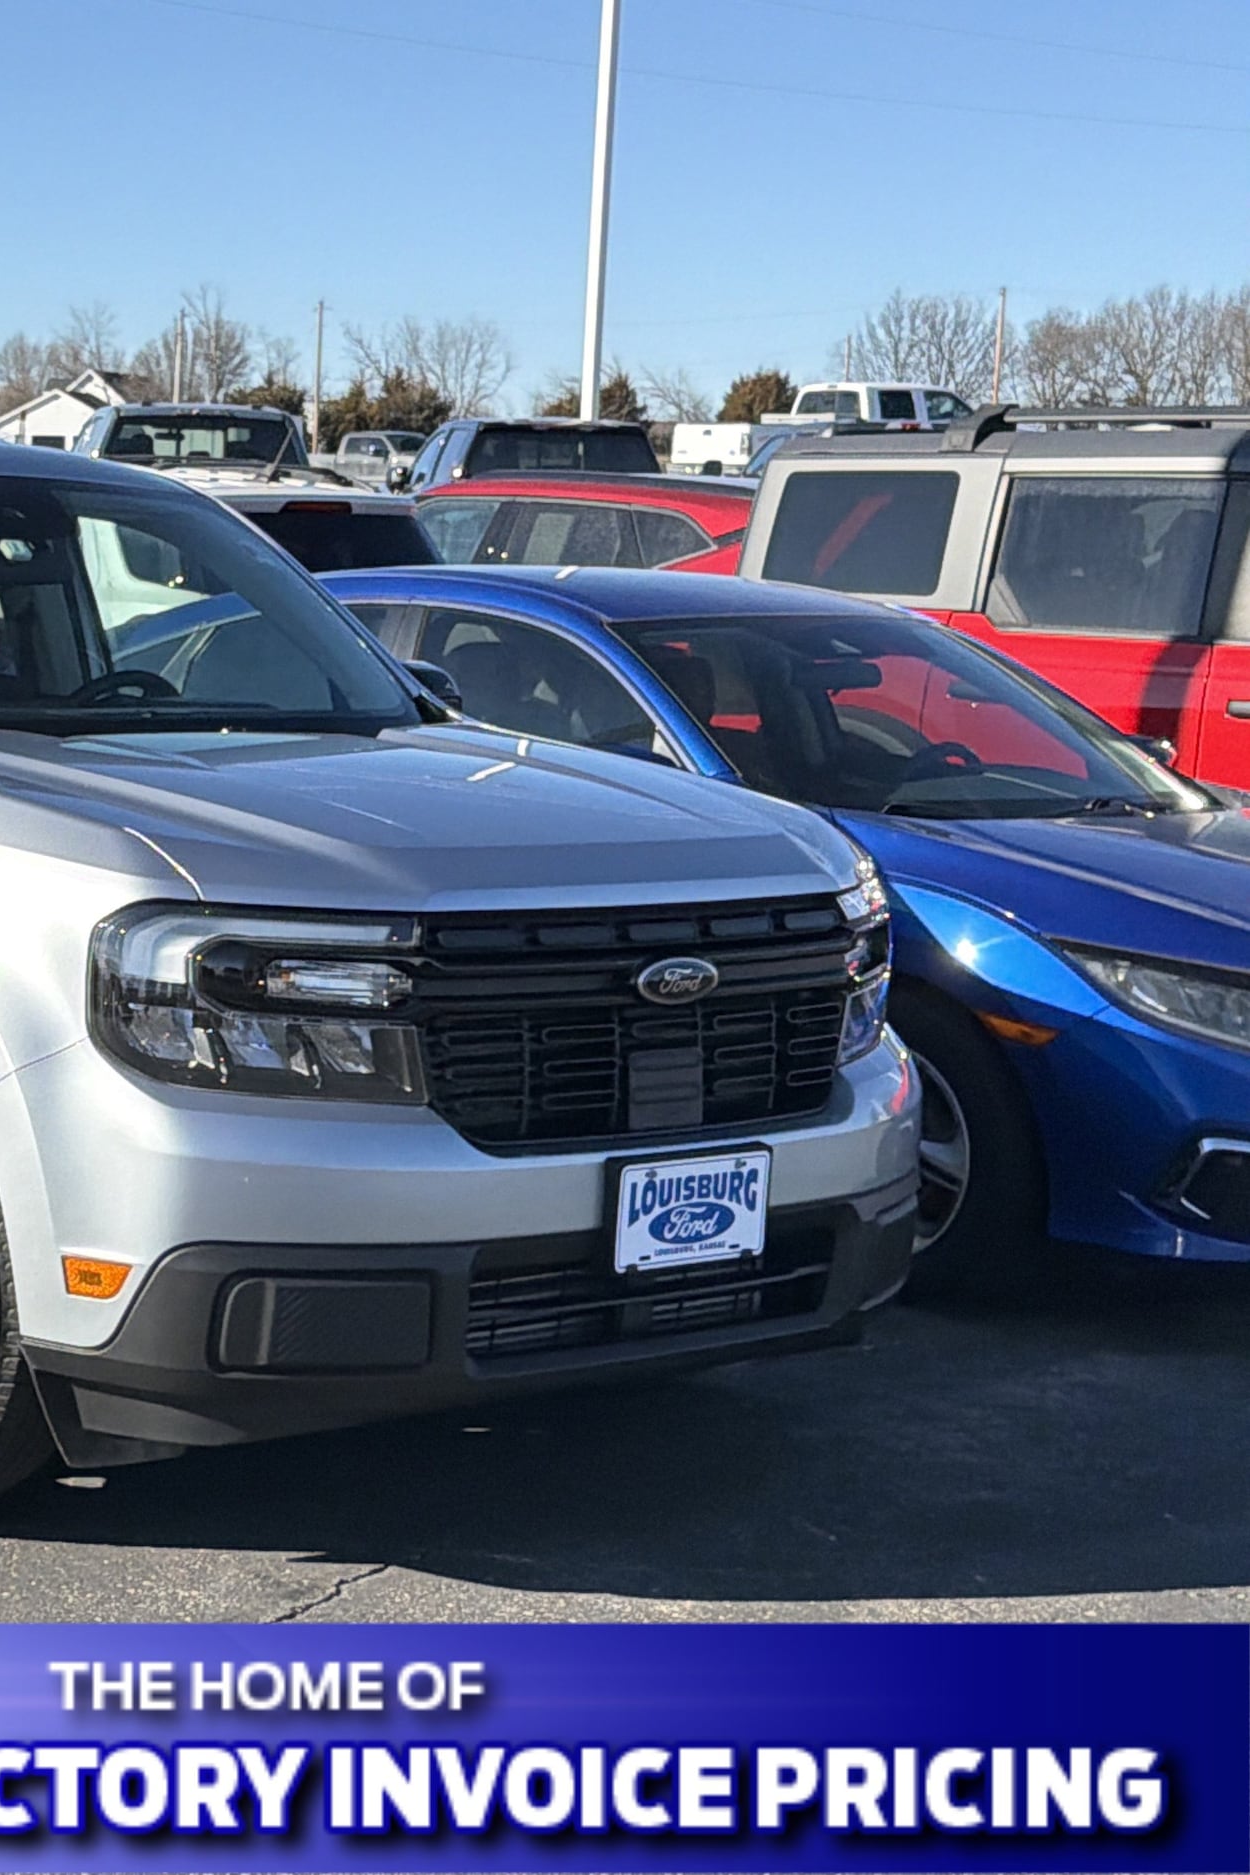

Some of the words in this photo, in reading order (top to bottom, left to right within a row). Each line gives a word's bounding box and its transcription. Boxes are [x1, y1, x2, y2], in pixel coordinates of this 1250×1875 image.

[659, 967, 704, 994] Ford
[627, 1167, 759, 1228] LOUISBURG
[663, 1206, 720, 1239] Ford
